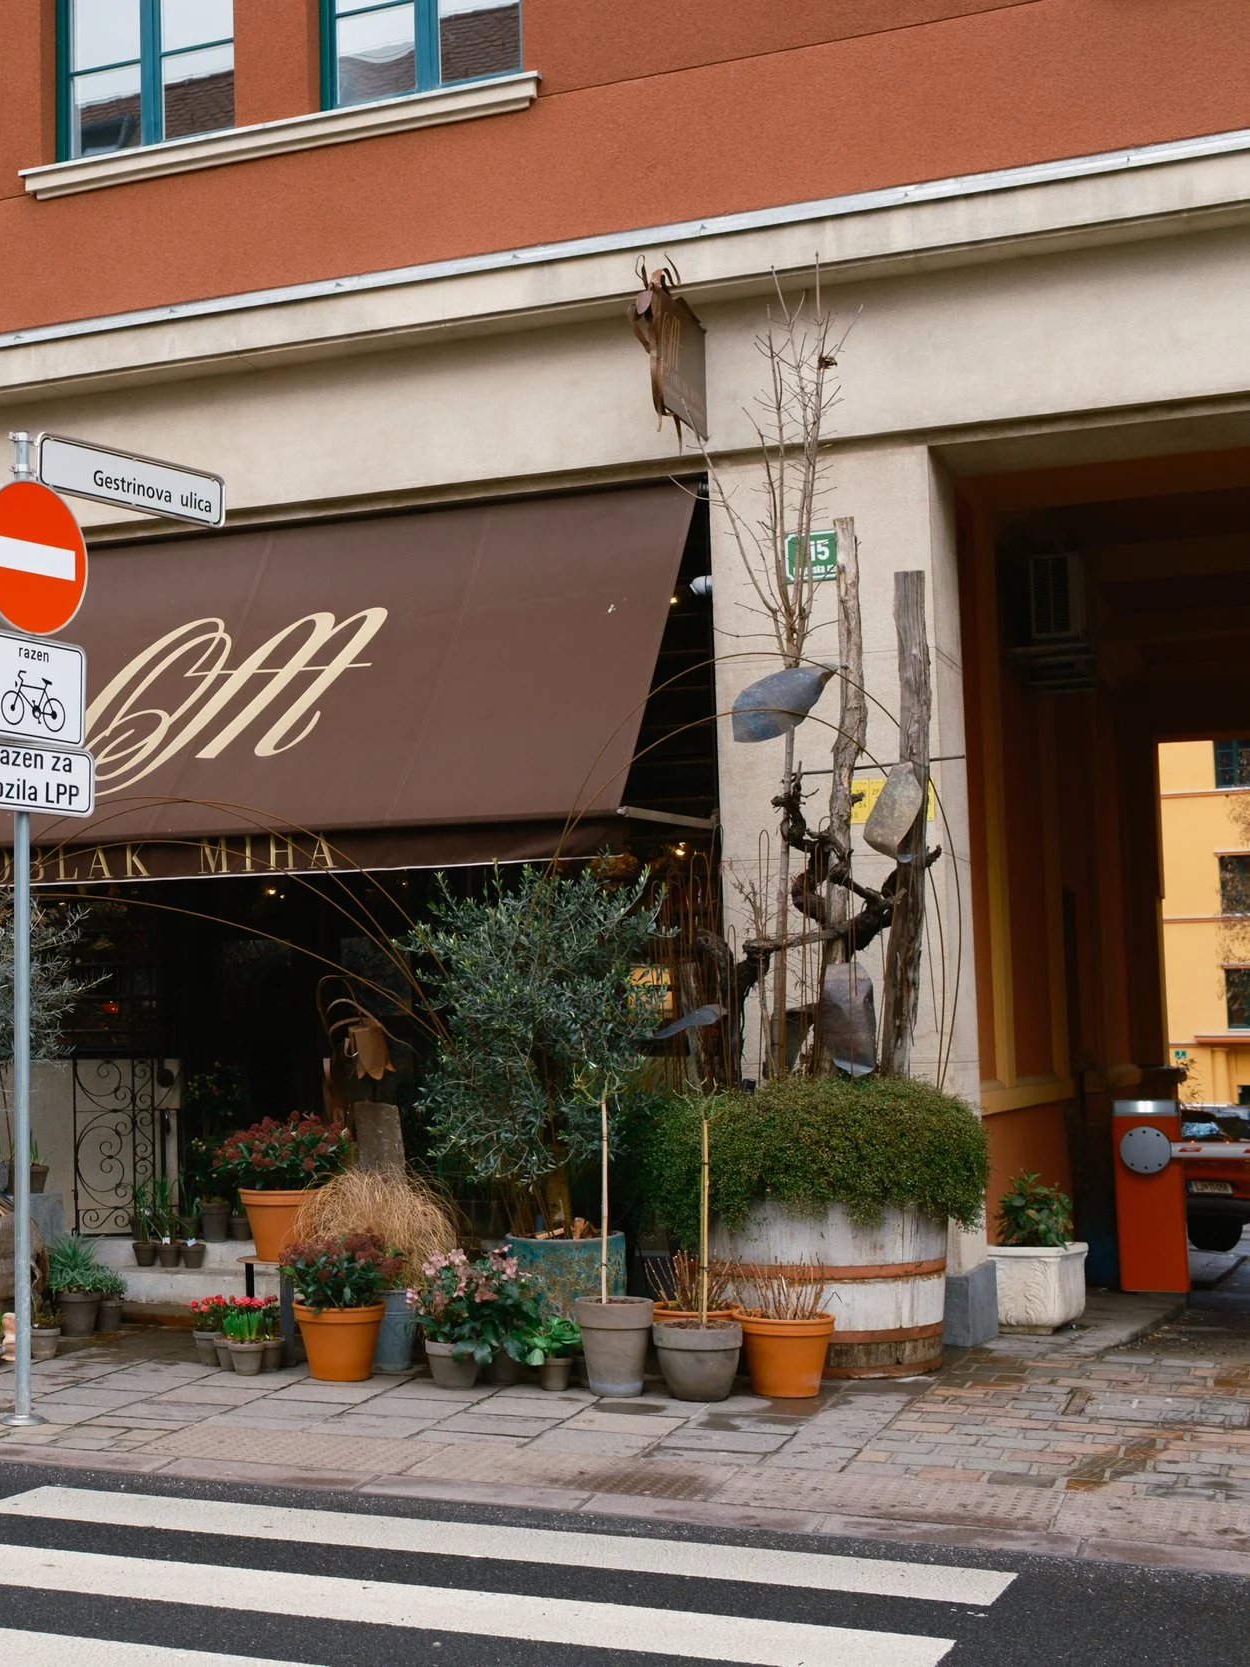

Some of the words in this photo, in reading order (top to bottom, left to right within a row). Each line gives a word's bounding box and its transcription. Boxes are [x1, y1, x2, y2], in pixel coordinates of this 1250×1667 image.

[93, 469, 172, 503] Gestrinova
[180, 491, 212, 513] ulica
[18, 647, 50, 663] razen
[51, 755, 72, 773] za
[45, 781, 80, 806] LPP
[197, 832, 338, 875] MIHA
